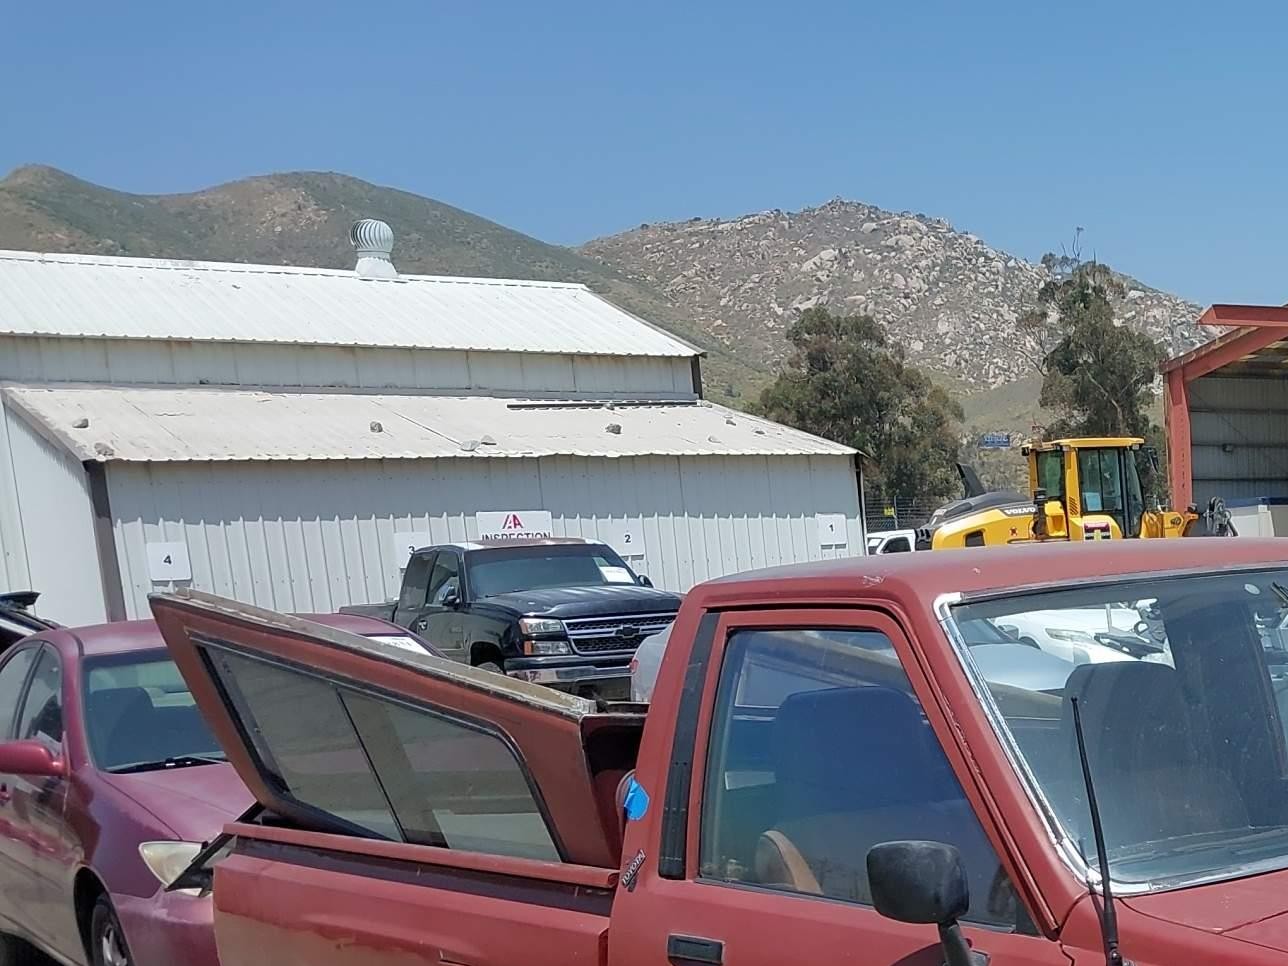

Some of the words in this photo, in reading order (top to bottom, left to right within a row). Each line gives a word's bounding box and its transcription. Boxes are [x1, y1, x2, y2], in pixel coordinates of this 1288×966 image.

[1004, 507, 1036, 515] VOLVO
[624, 534, 632, 544] 2
[408, 545, 416, 556] 3
[163, 555, 172, 565] 4
[622, 849, 646, 886] TOYOTA
